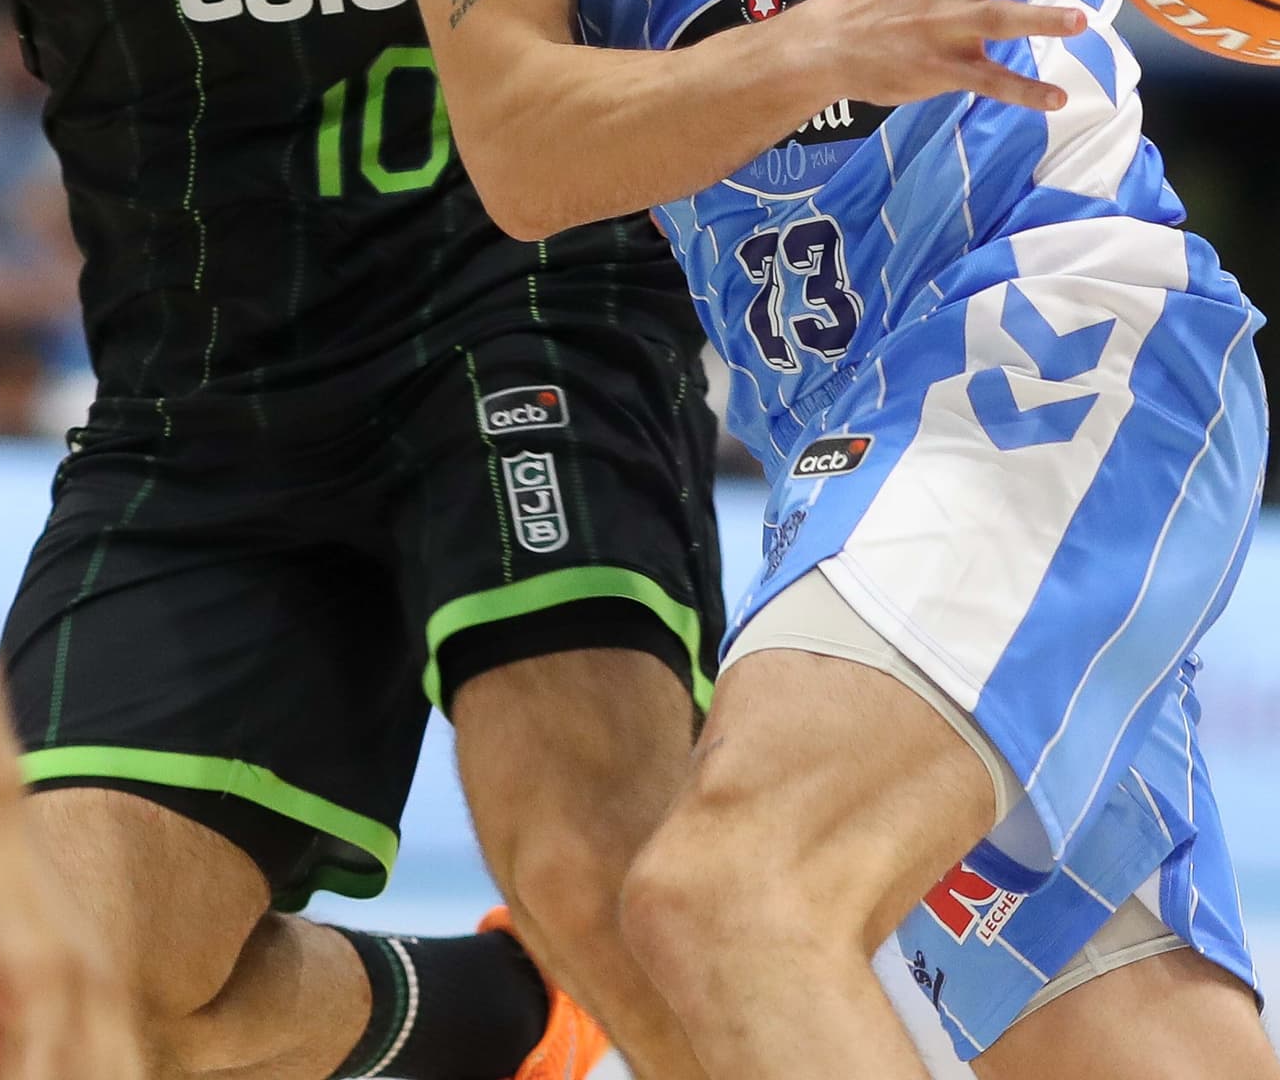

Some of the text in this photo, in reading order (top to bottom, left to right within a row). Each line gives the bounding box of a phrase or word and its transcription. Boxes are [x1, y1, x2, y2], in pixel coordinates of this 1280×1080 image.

[316, 46, 451, 198] 10
[735, 214, 864, 374] 73
[490, 404, 548, 427] acb
[800, 450, 848, 472] acb
[514, 461, 558, 542] CJB
[979, 891, 1019, 940] LECHE
